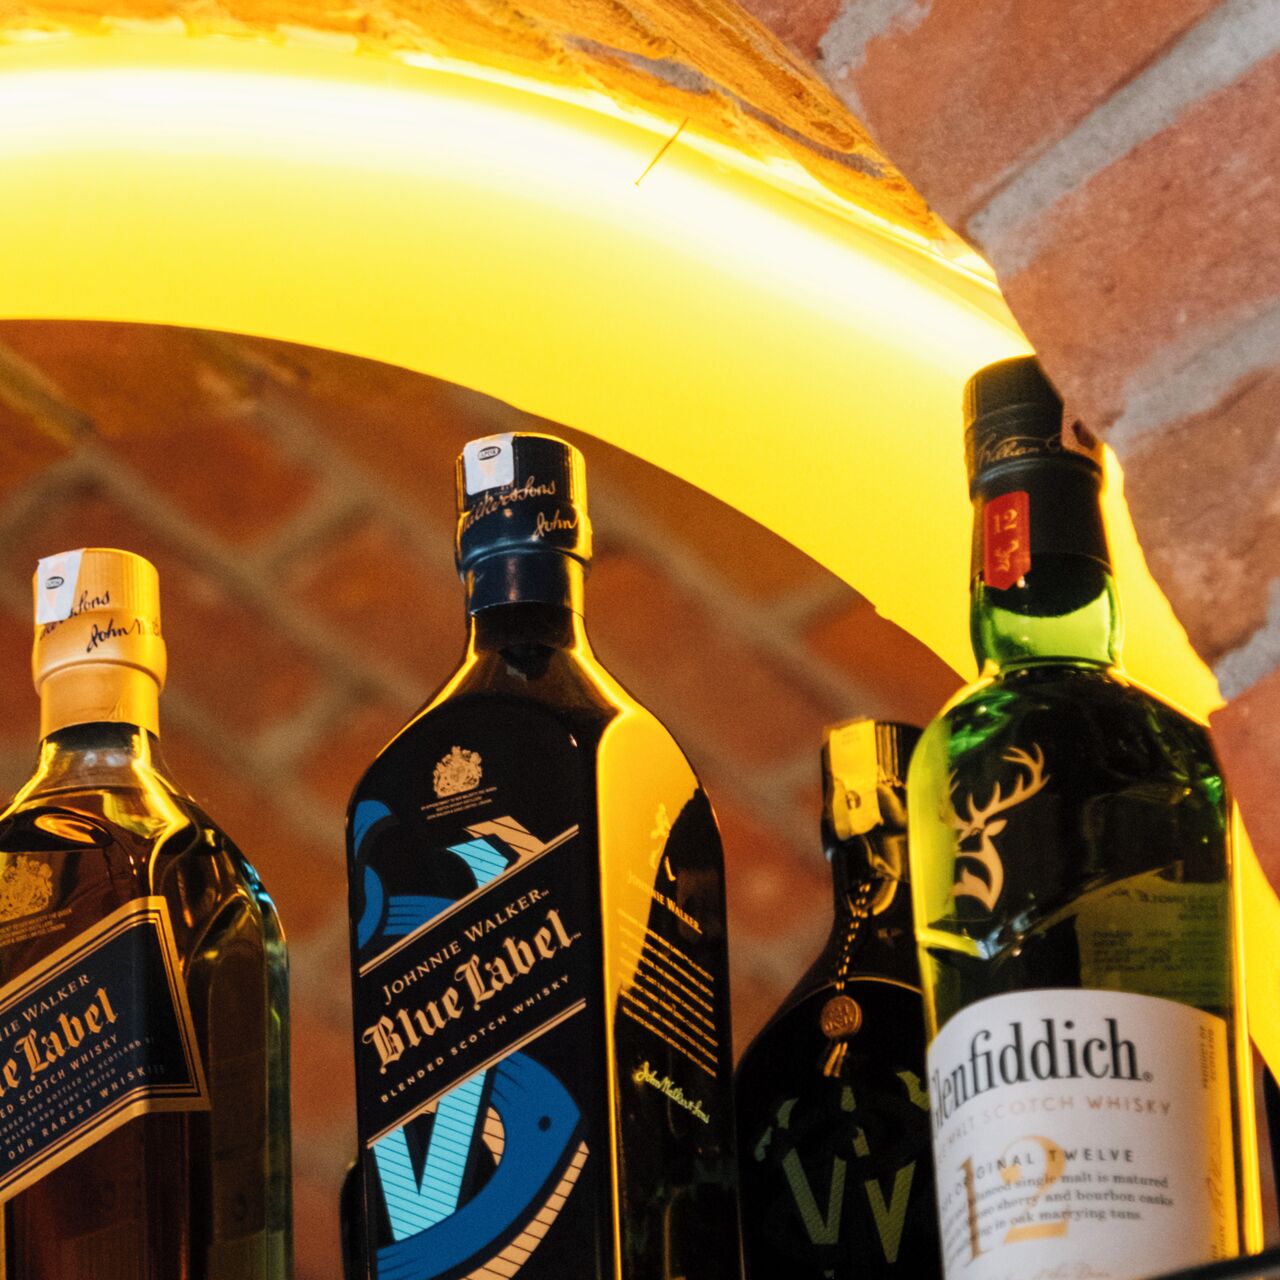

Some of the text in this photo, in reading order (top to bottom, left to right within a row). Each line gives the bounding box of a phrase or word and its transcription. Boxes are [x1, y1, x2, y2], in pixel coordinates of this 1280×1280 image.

[531, 509, 579, 542] John
[993, 509, 1018, 534] 12
[86, 618, 128, 654] John
[383, 887, 542, 1005] JOHNNIE WALKER
[22, 973, 91, 1023] WALKER
[362, 984, 464, 1074] Blue
[454, 908, 573, 1012] Label
[13, 986, 120, 1081] Label
[381, 974, 570, 1103] BLENDED SCOTCH WHISKY
[19, 1068, 65, 1105] SCOTCH
[70, 1033, 117, 1071] WHISKY
[932, 1018, 1143, 1126] lenfiddich
[8, 1138, 34, 1160] OUR
[41, 1099, 92, 1138] RAREST
[1086, 1095, 1170, 1115] WHISKY
[1049, 1148, 1134, 1164] TWELVE
[1061, 1172, 1093, 1184] malt
[1097, 1172, 1109, 1183] is
[1113, 1173, 1169, 1189] matured
[960, 1135, 1068, 1260] 12
[1045, 1191, 1071, 1202] and
[1076, 1189, 1135, 1203] bourbon
